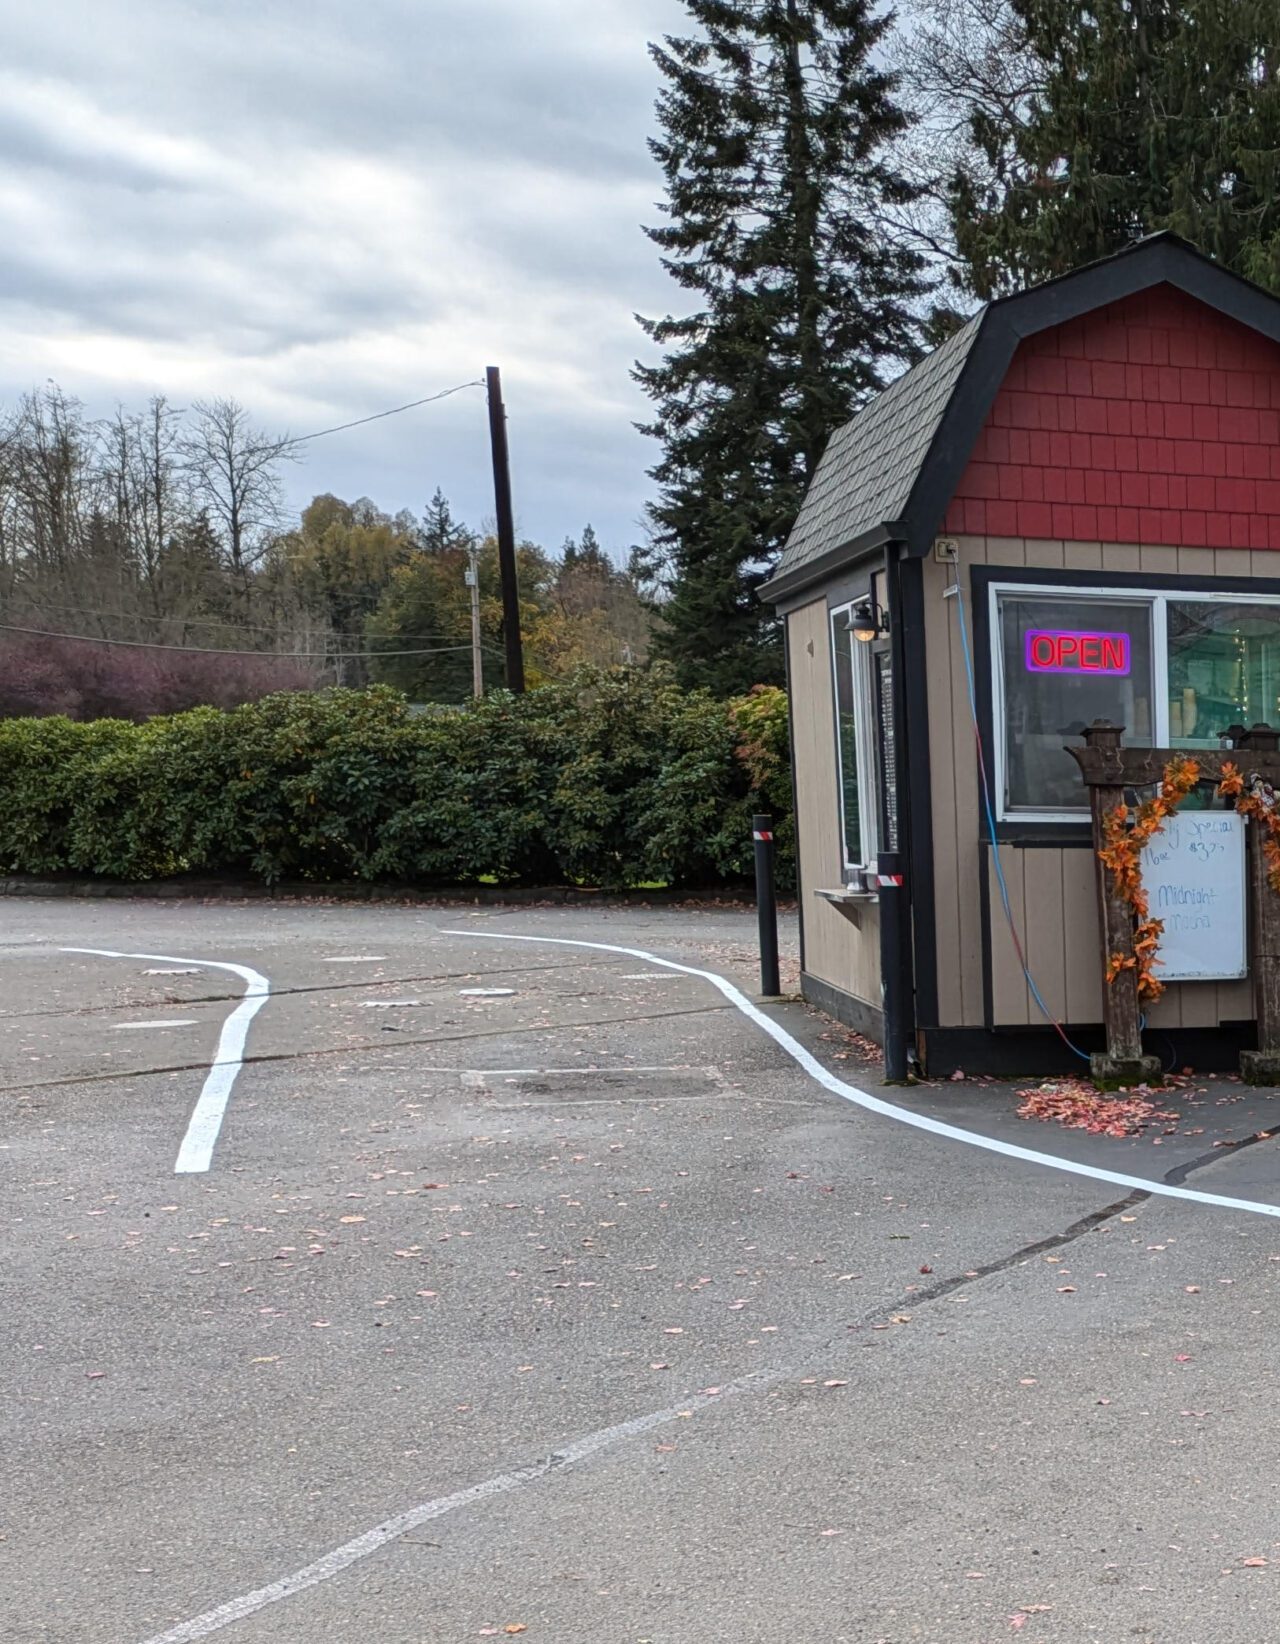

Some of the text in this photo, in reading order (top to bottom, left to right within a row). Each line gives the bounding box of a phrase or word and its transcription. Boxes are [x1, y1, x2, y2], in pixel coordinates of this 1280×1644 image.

[1030, 635, 1126, 670] OPEN
[1187, 819, 1234, 839] Special
[1158, 885, 1219, 912] Midnight
